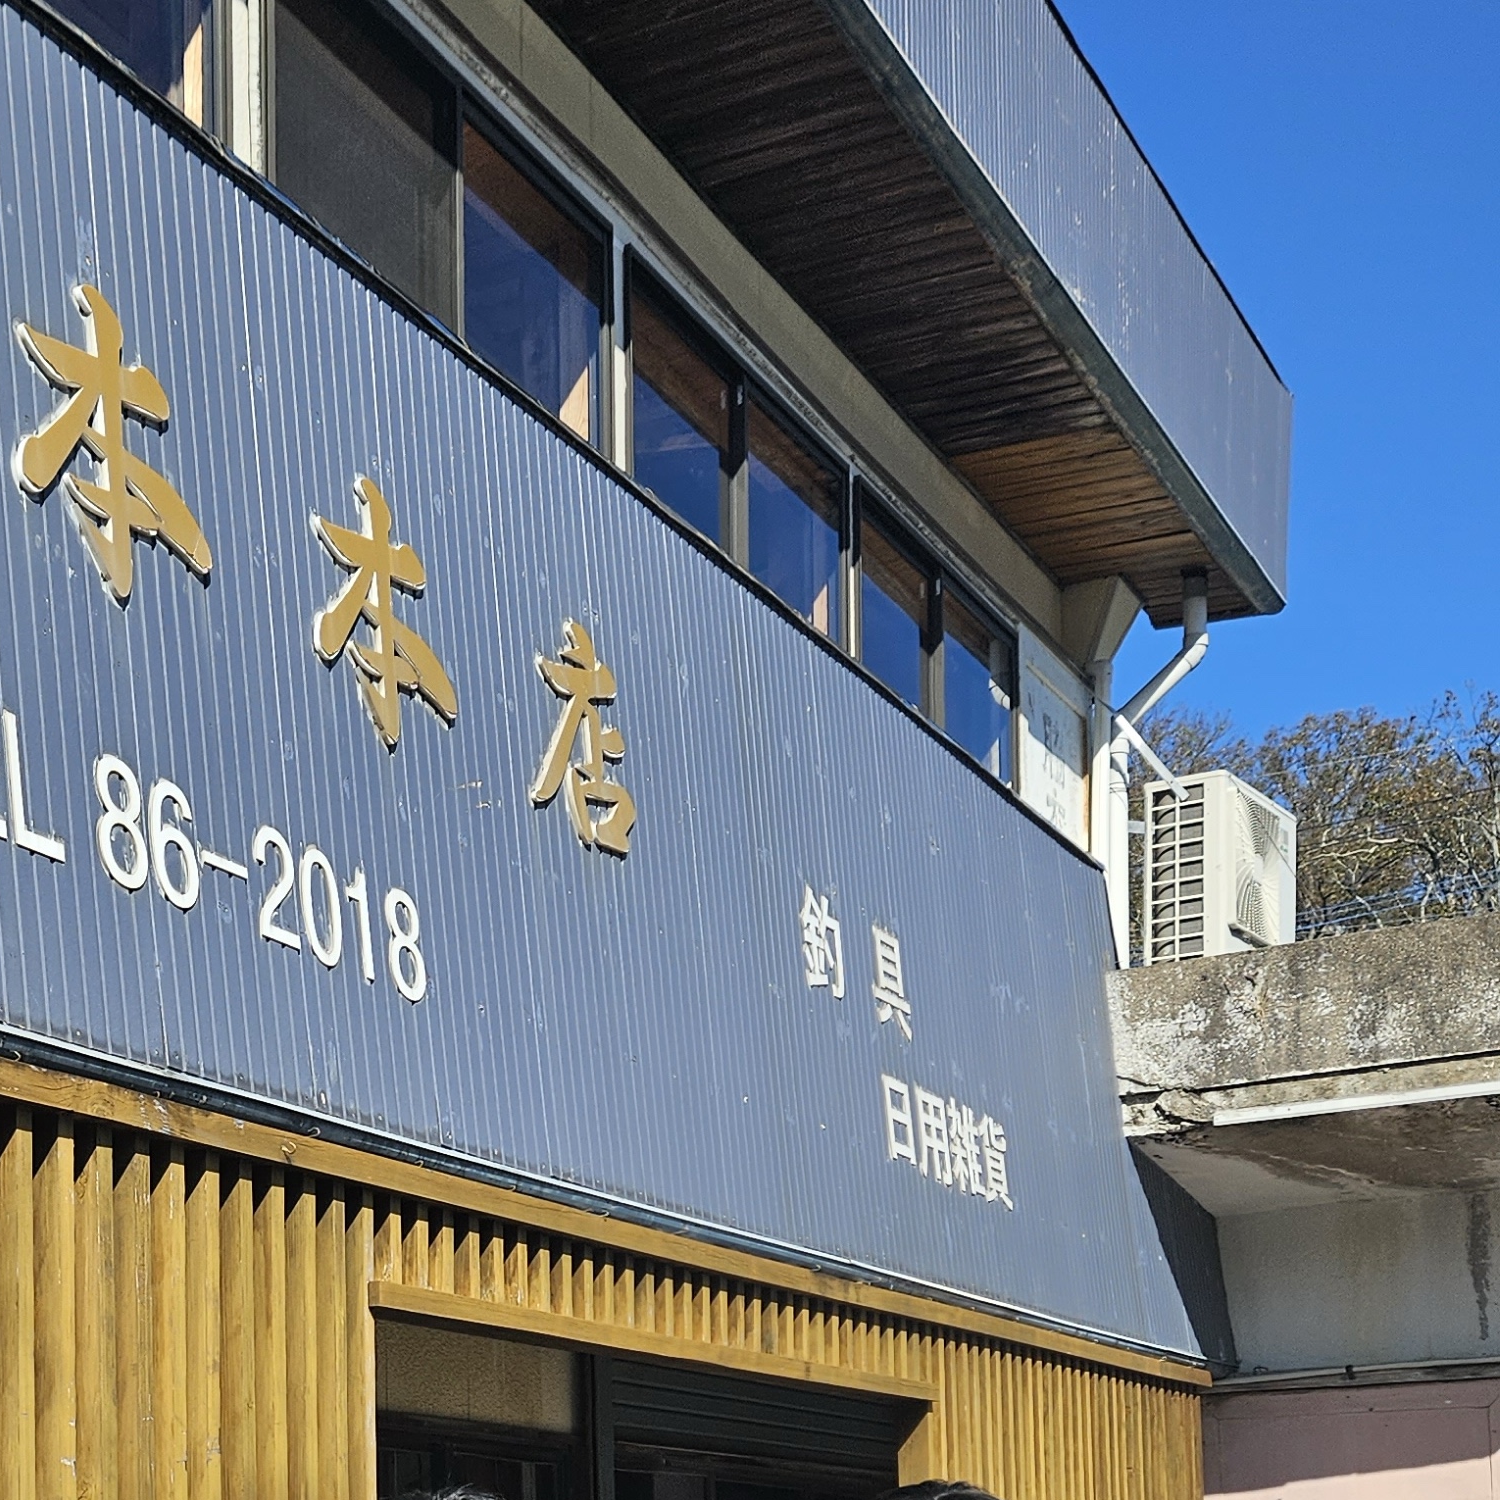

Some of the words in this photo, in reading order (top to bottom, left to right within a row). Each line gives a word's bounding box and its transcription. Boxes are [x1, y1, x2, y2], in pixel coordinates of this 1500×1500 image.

[94, 752, 427, 1003] 86-2018
[881, 1073, 1013, 1211] 日用雑貨
